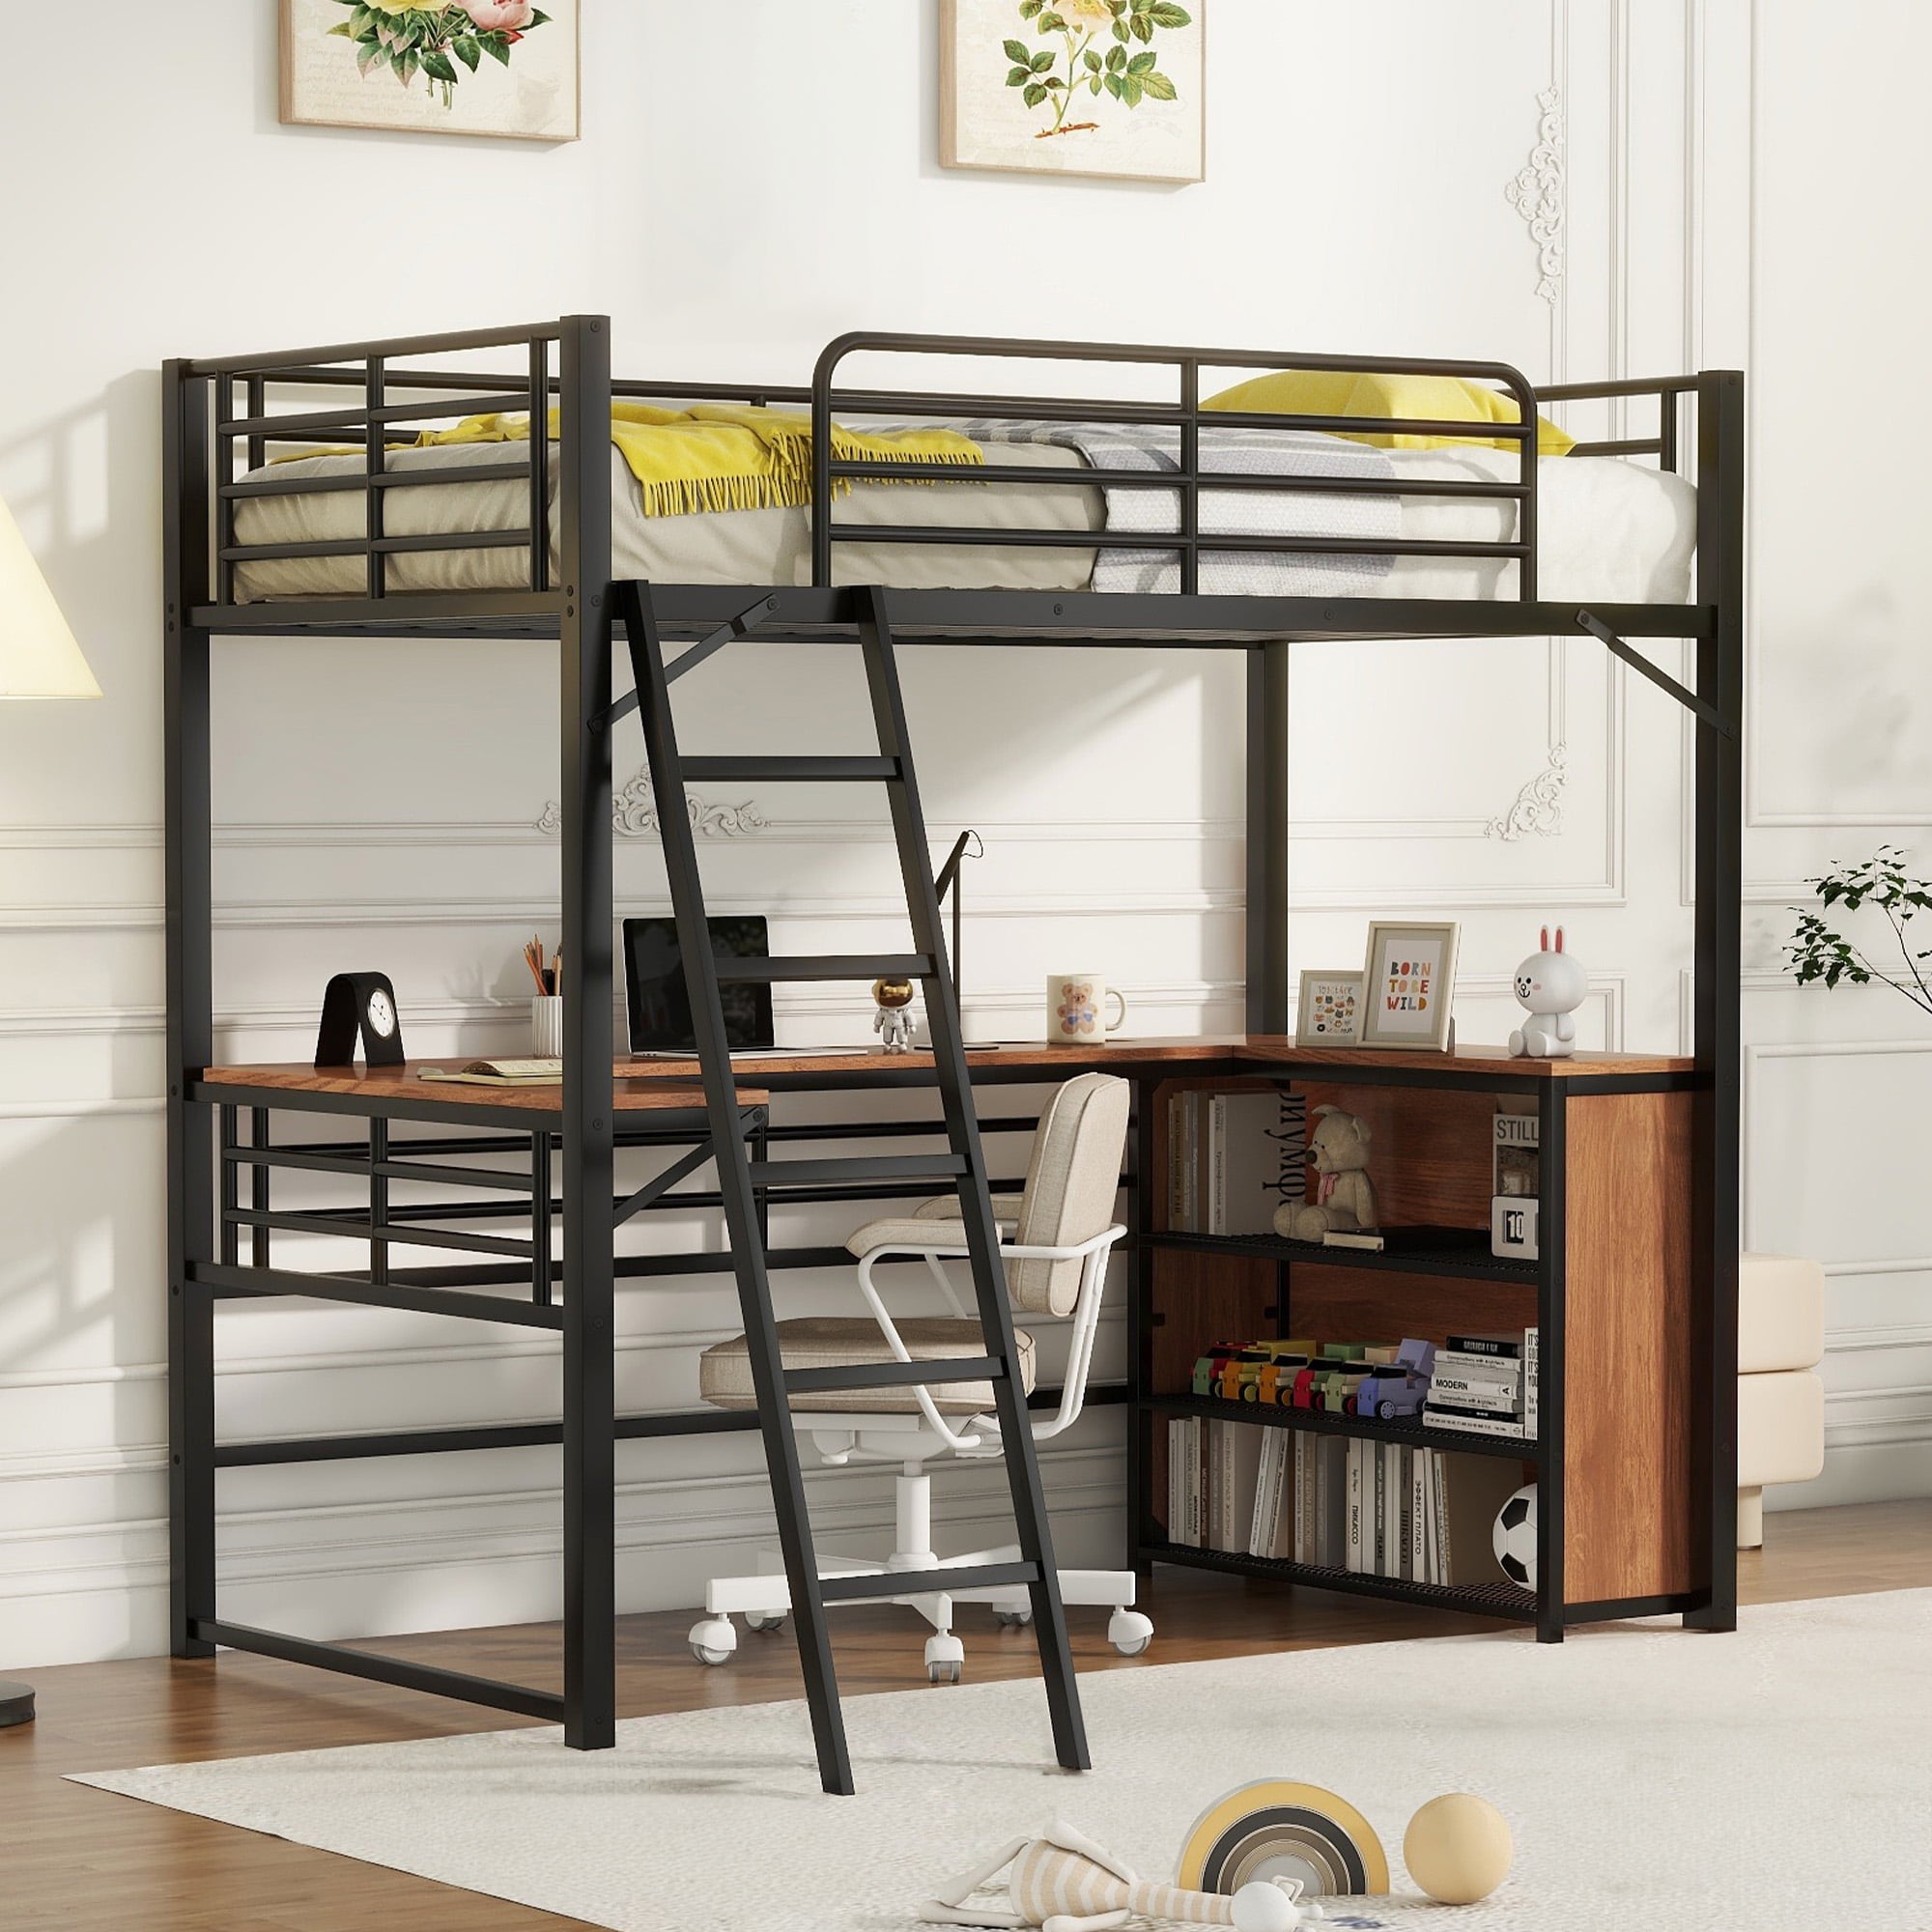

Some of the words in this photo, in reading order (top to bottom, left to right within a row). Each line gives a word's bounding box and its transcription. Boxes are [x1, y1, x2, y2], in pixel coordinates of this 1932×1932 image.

[1390, 961, 1432, 976] BORN
[1388, 980, 1408, 993] TO
[1410, 980, 1430, 993] BE
[1386, 996, 1427, 1010] WILD
[1496, 1119, 1539, 1141] STILL
[1435, 1378, 1468, 1391] MODERN
